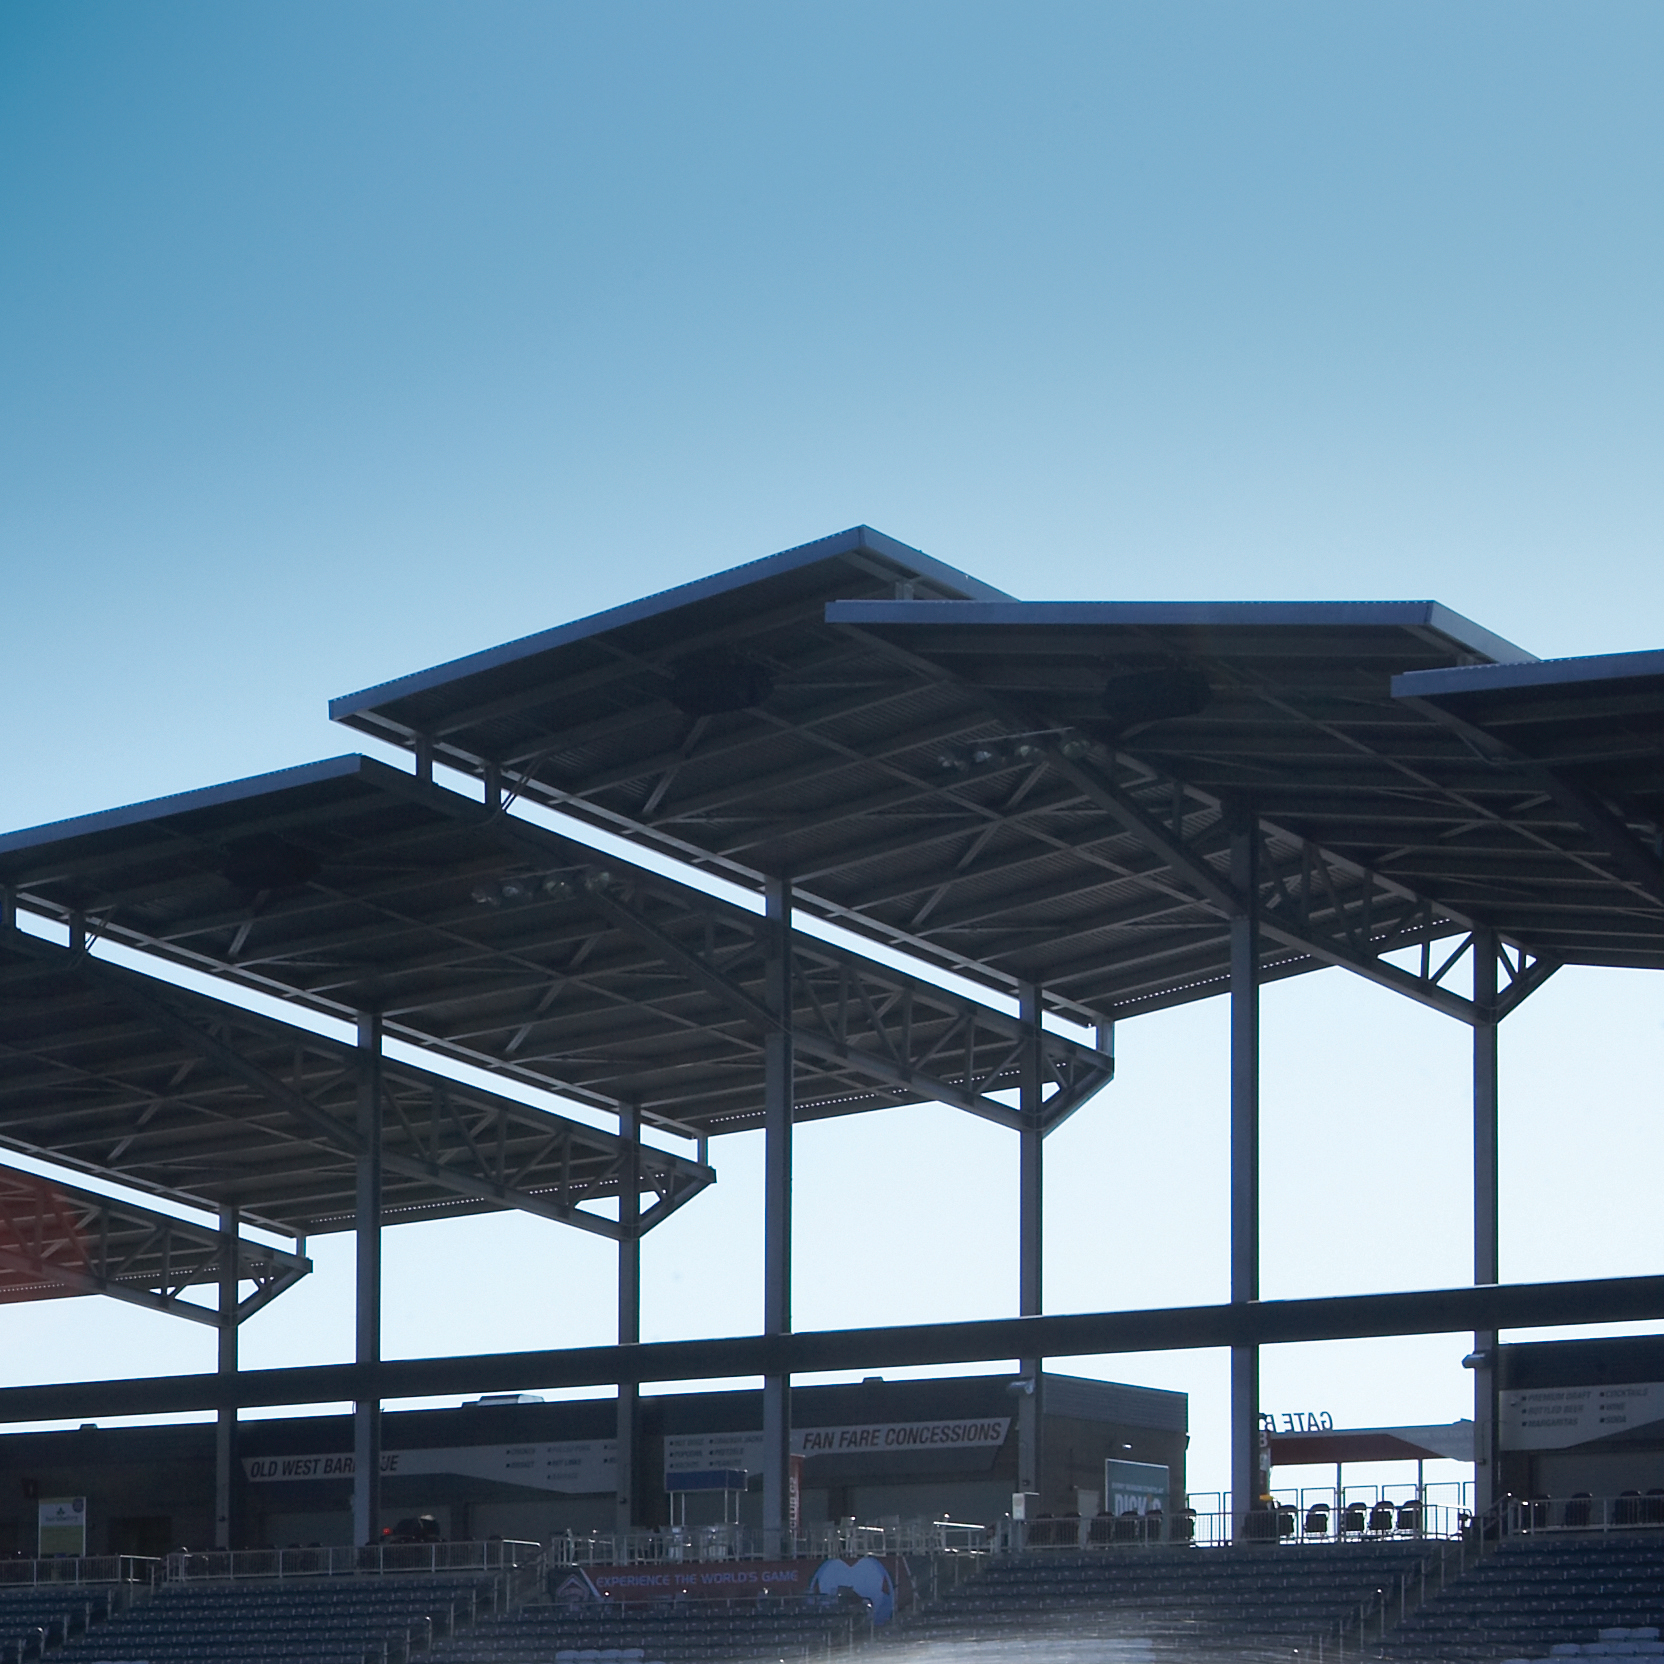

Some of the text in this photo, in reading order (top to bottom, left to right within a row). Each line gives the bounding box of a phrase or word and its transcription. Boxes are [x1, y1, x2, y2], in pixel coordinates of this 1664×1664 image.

[802, 1422, 1002, 1450] FAN FARE CONCESSIONS
[250, 1455, 399, 1478] OLD WEST BARUE
[596, 1570, 798, 1588] EXPERIENCE THE WORLD'S GAME
